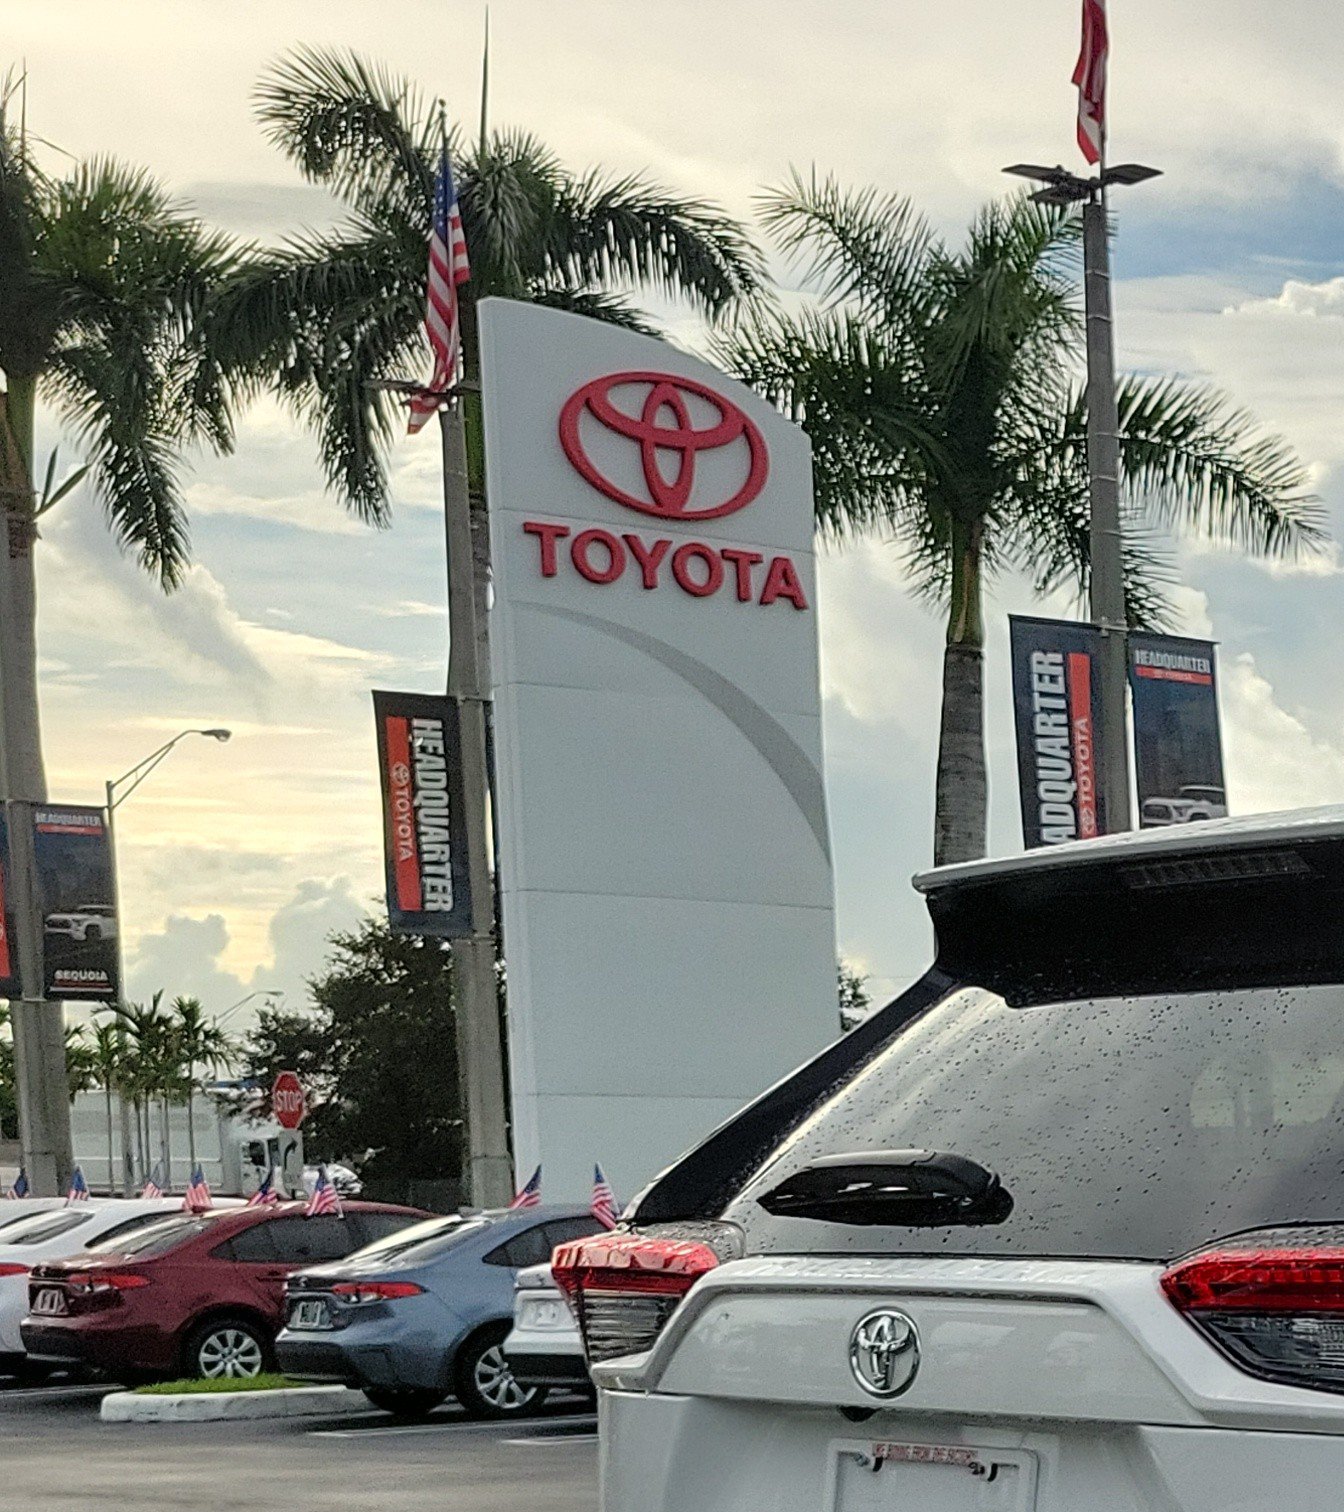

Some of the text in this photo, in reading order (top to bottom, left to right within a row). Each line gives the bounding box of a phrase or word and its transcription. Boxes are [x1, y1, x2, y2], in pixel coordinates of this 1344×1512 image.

[523, 521, 808, 610] TOYOTA
[1134, 649, 1211, 674] HEADQUARTER
[1031, 650, 1077, 843] ADQUARTER
[1073, 718, 1093, 801] TOYOTA
[395, 788, 414, 861] TOYOTA
[411, 718, 453, 912] HEADQUARTER
[54, 969, 108, 981] SEQUOIA
[276, 1090, 302, 1111] STOP
